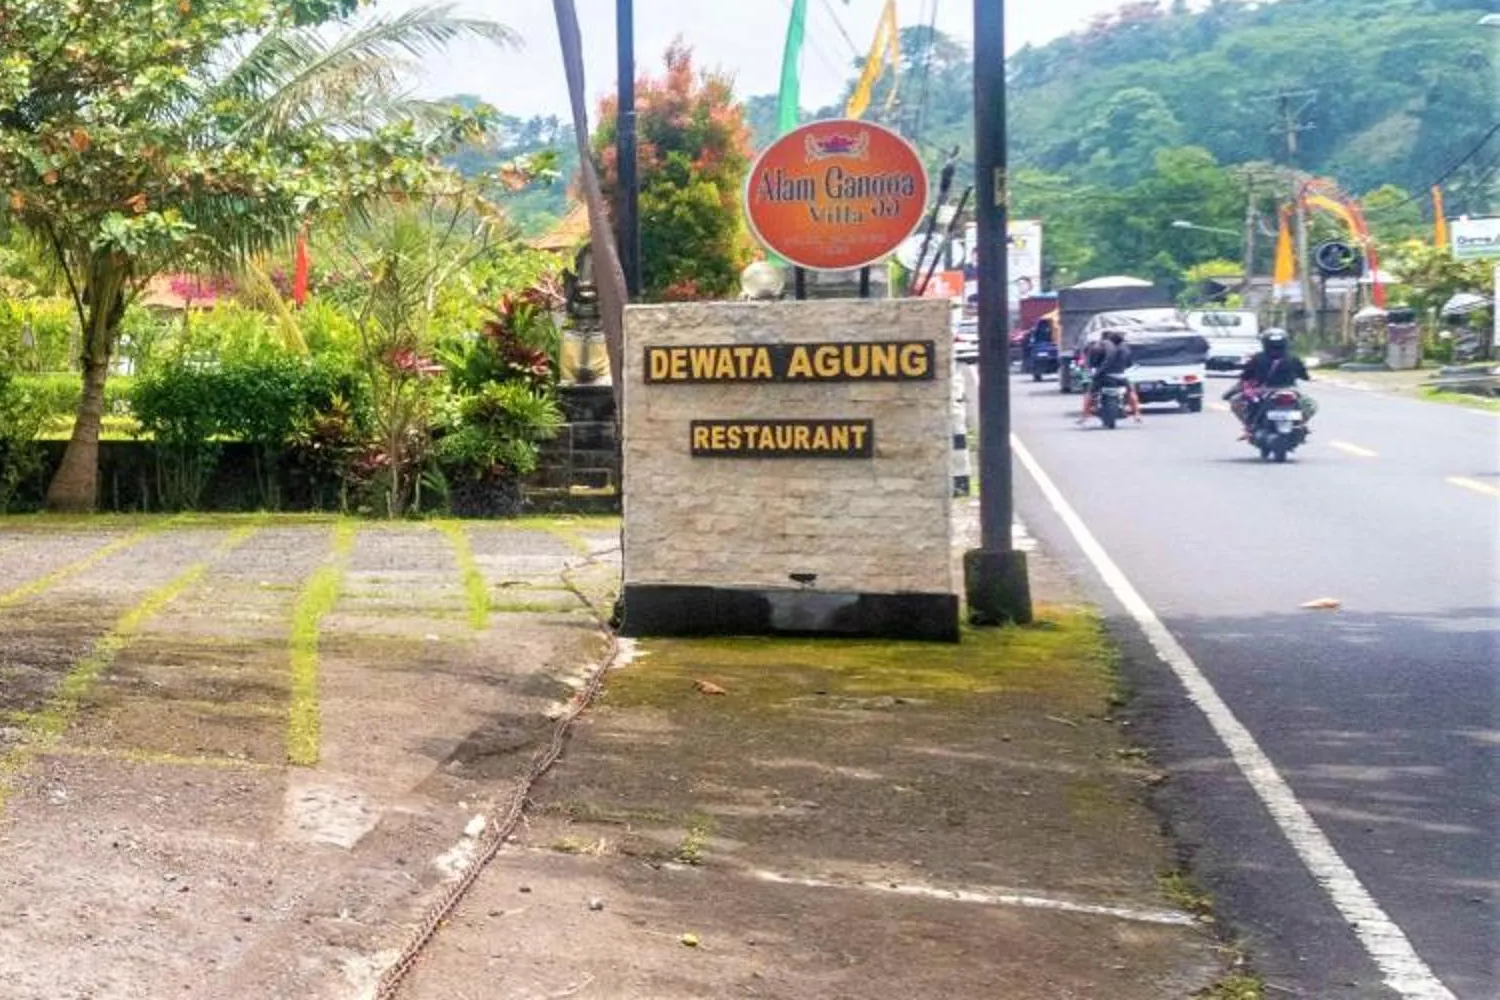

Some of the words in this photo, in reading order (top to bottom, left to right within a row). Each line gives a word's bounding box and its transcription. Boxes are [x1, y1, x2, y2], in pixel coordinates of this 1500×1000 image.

[757, 168, 816, 201] Alam
[650, 347, 773, 380] DEWATA
[787, 344, 928, 378] AGUNG
[693, 425, 867, 450] RESTAURANT
